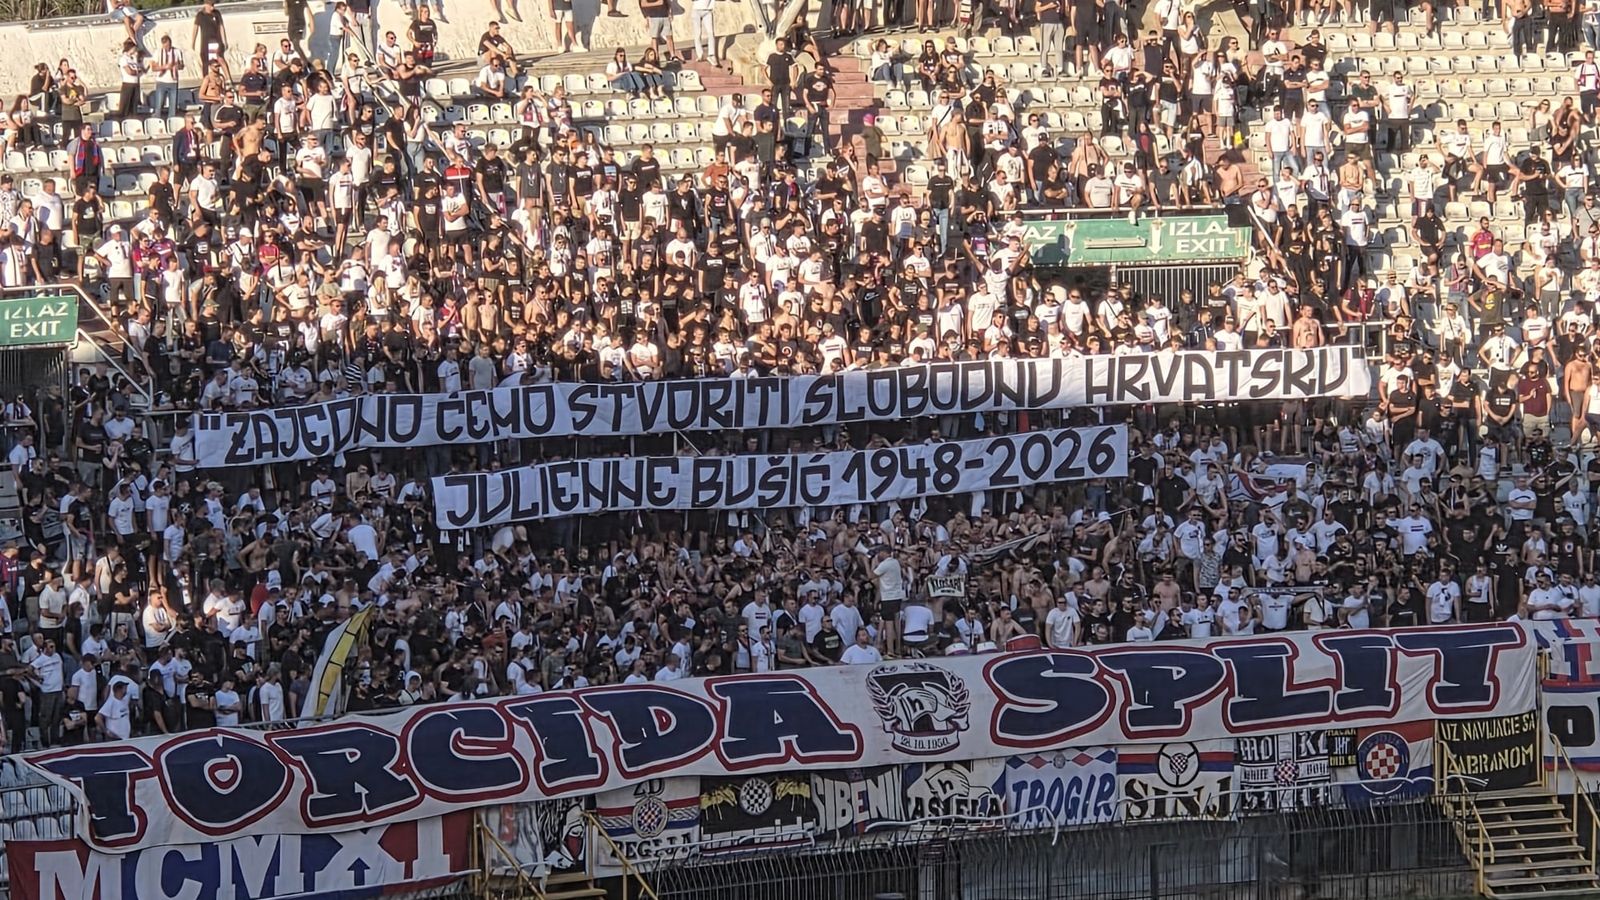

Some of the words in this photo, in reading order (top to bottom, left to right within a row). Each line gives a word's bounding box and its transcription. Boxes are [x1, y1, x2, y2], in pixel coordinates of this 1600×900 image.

[1176, 237, 1229, 254] EXIT
[10, 320, 61, 338] EXIT
[571, 377, 790, 432] STVORITI
[802, 358, 1064, 422] SLOBODNU
[447, 457, 678, 527] JULIENNE
[691, 454, 831, 510] BUŠIĆ
[842, 427, 1116, 501] 1948-2026
[24, 676, 864, 848] TORCIDA
[983, 621, 1527, 748] SPLIT
[1440, 722, 1460, 742] UZ
[1522, 712, 1535, 732] SA
[1448, 743, 1534, 775] ZABRANOM
[1011, 774, 1117, 829] TROGIR
[1124, 775, 1232, 820] SINJ
